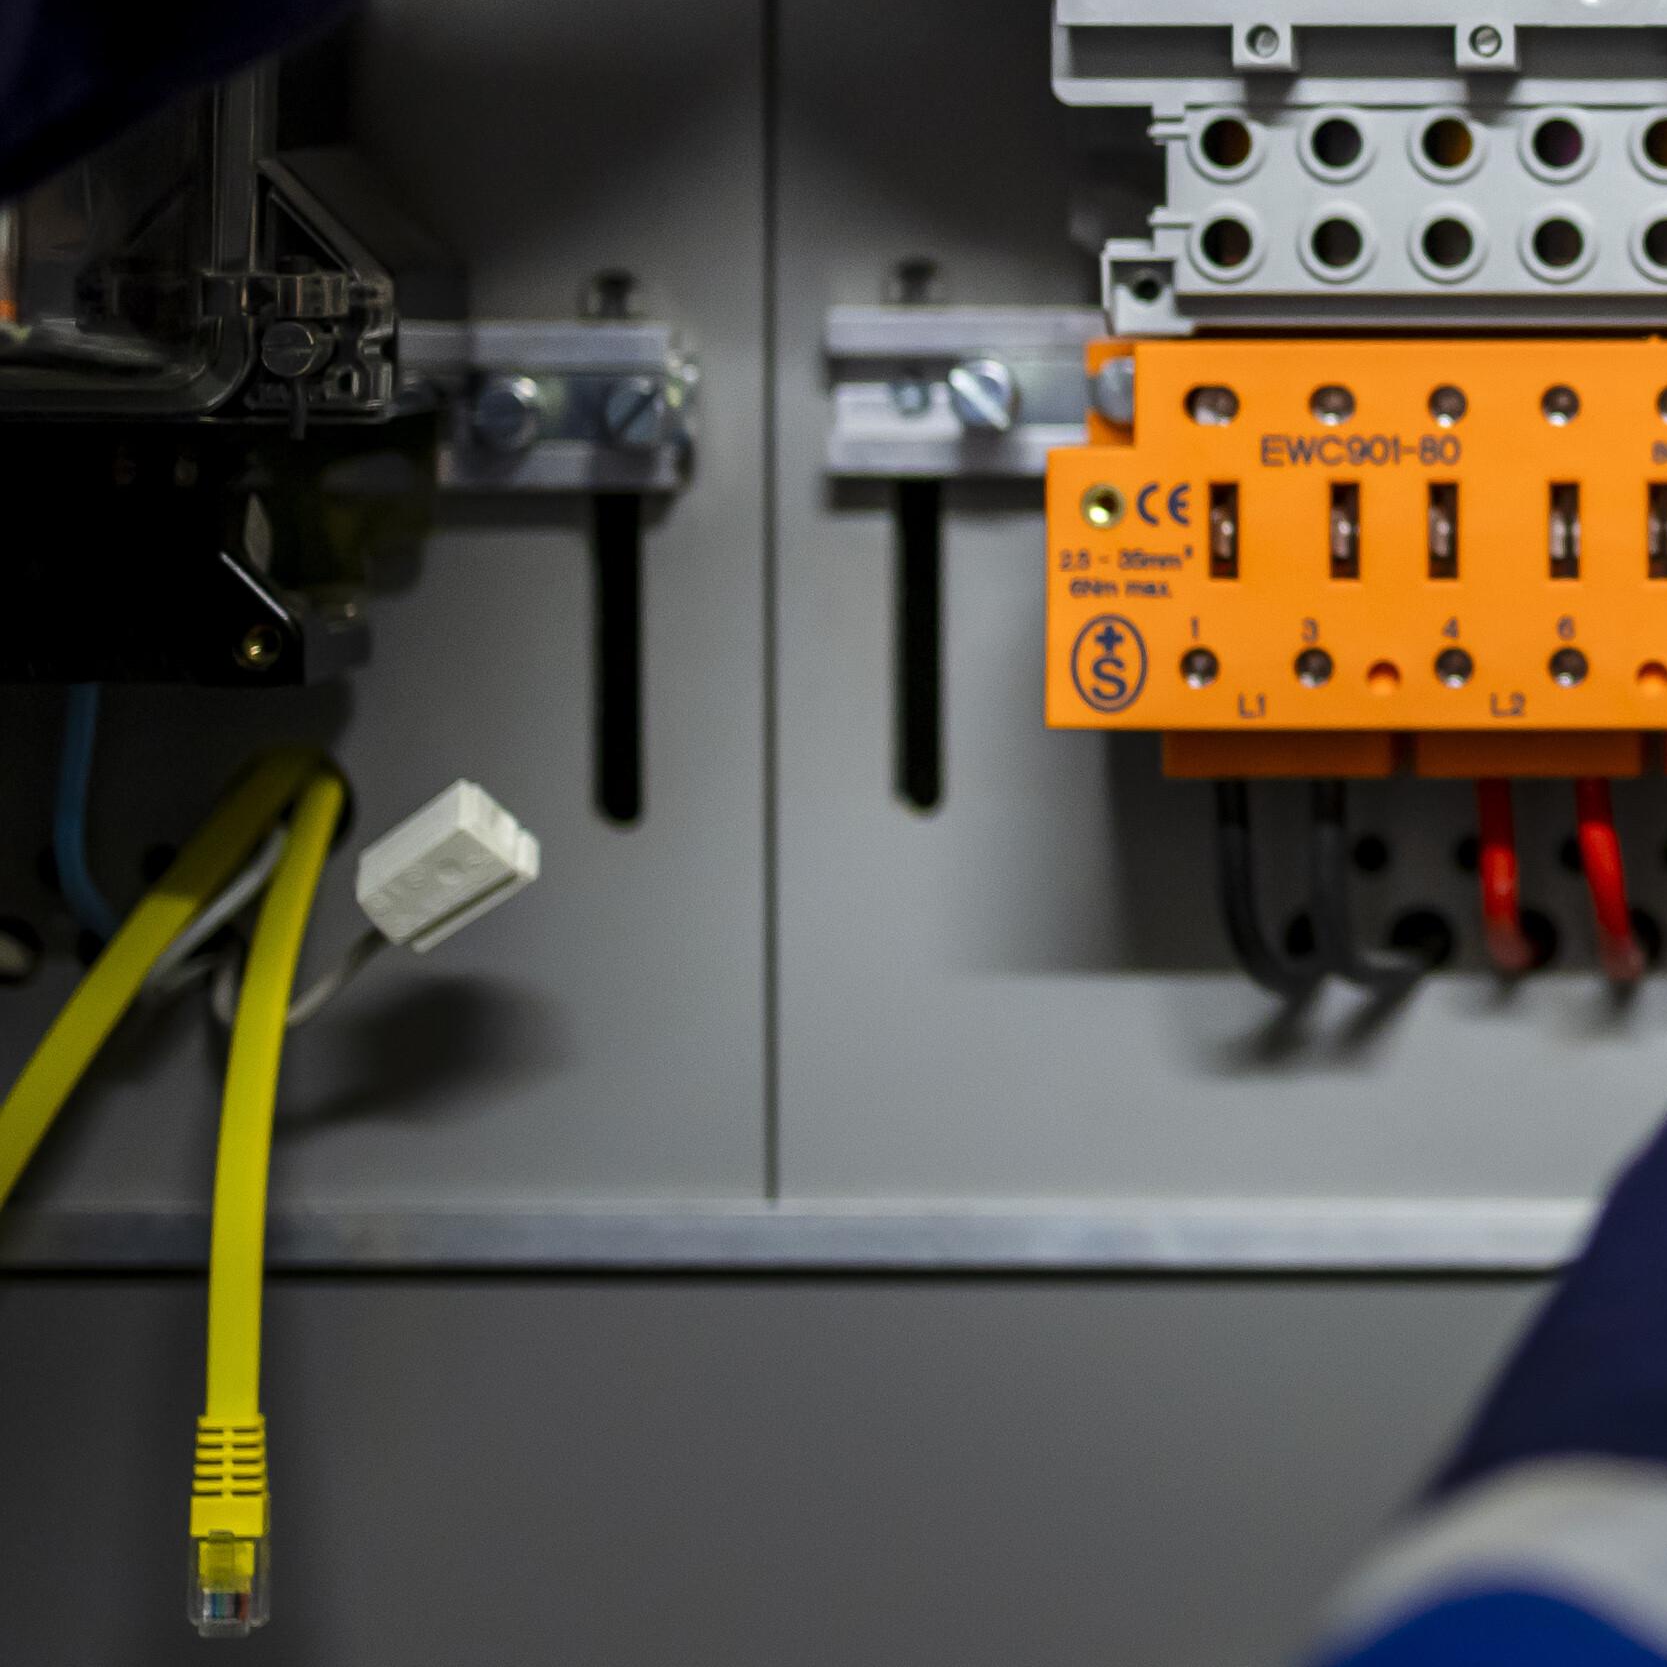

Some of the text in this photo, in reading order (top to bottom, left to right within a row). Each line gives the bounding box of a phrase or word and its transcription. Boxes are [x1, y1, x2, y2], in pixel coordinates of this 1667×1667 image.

[1261, 435, 1461, 467] EWC901-80
[1191, 619, 1199, 638] 1
[1303, 620, 1317, 641] 3
[1442, 618, 1459, 638] 4
[1558, 618, 1575, 639] 6
[1239, 695, 1265, 717] L1
[1491, 695, 1525, 717] L2
